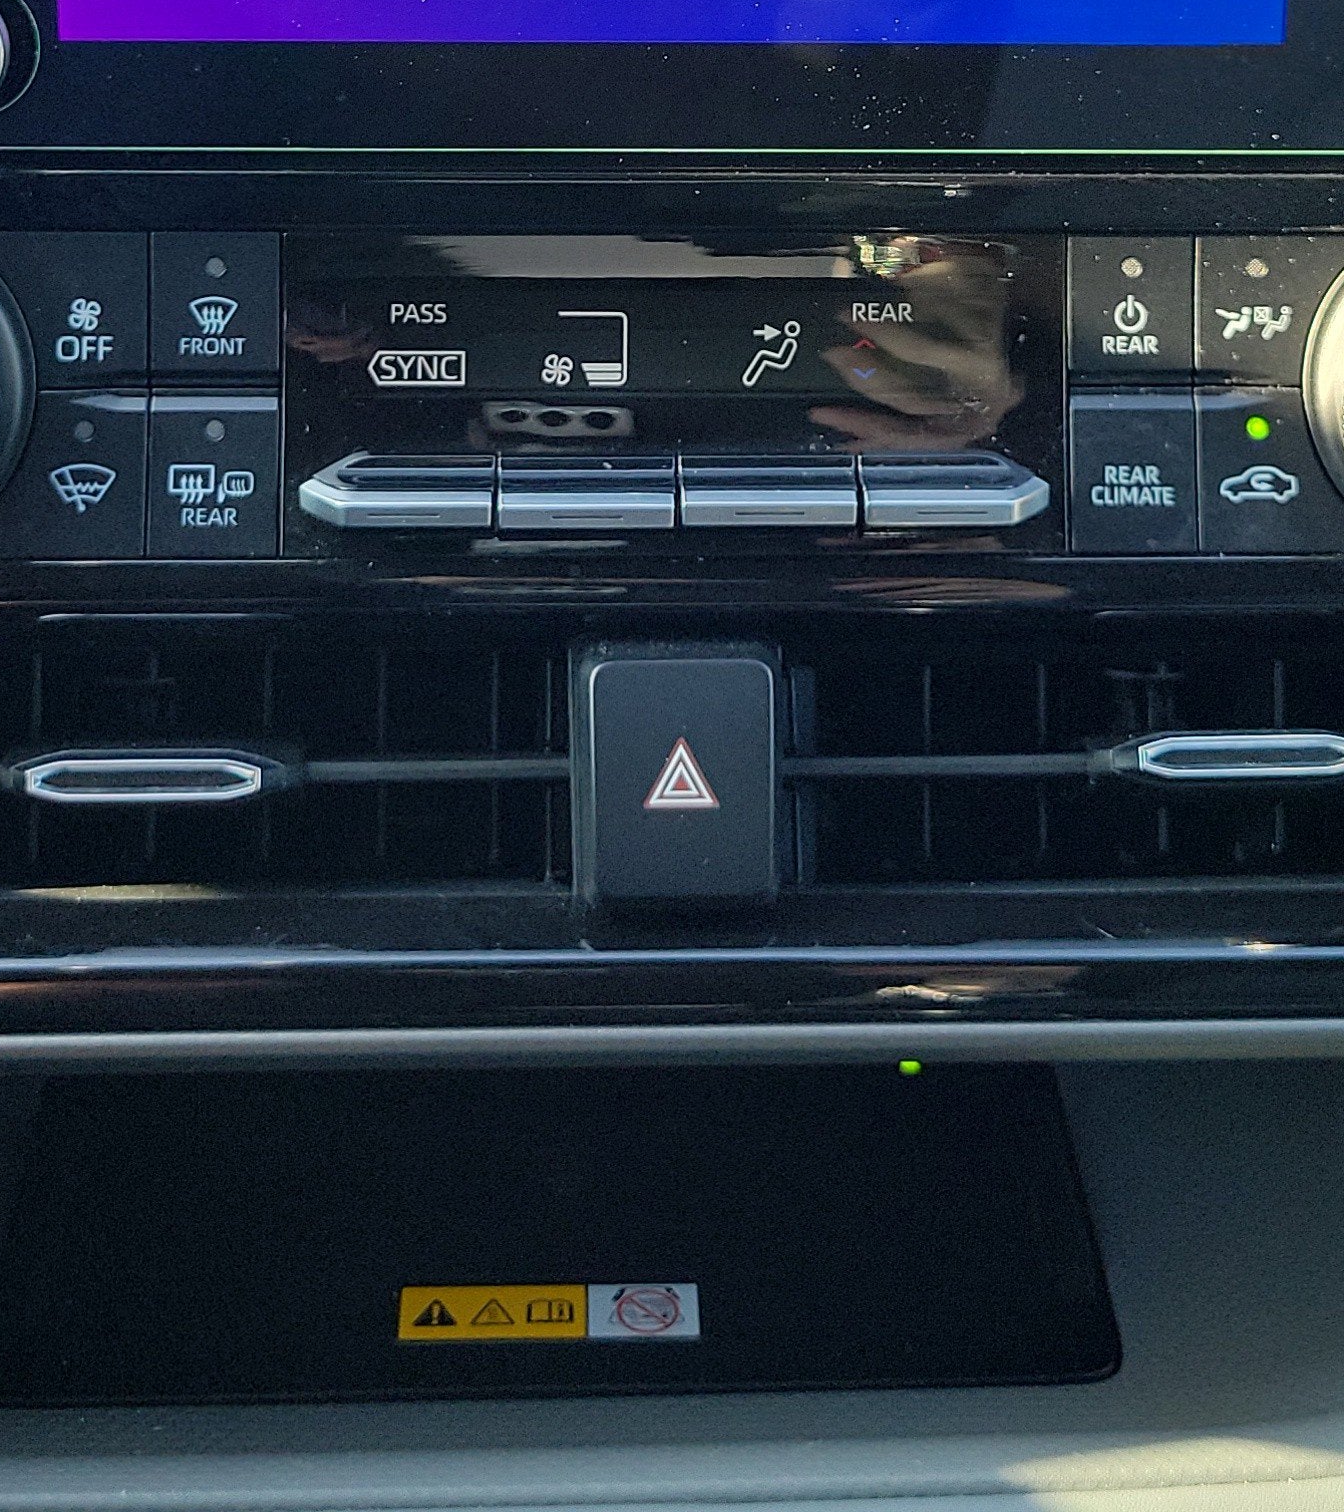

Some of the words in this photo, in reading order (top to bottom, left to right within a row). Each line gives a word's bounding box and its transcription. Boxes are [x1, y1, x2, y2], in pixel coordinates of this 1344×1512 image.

[390, 303, 448, 324] PASS
[852, 302, 913, 323] REAR
[56, 335, 114, 362] OFF
[179, 335, 247, 357] FRONT
[1102, 334, 1159, 356] REAR
[377, 354, 460, 383] SYNC
[1103, 464, 1161, 485] REAR
[1091, 485, 1176, 508] CLIMATE
[181, 507, 239, 527] REAR
